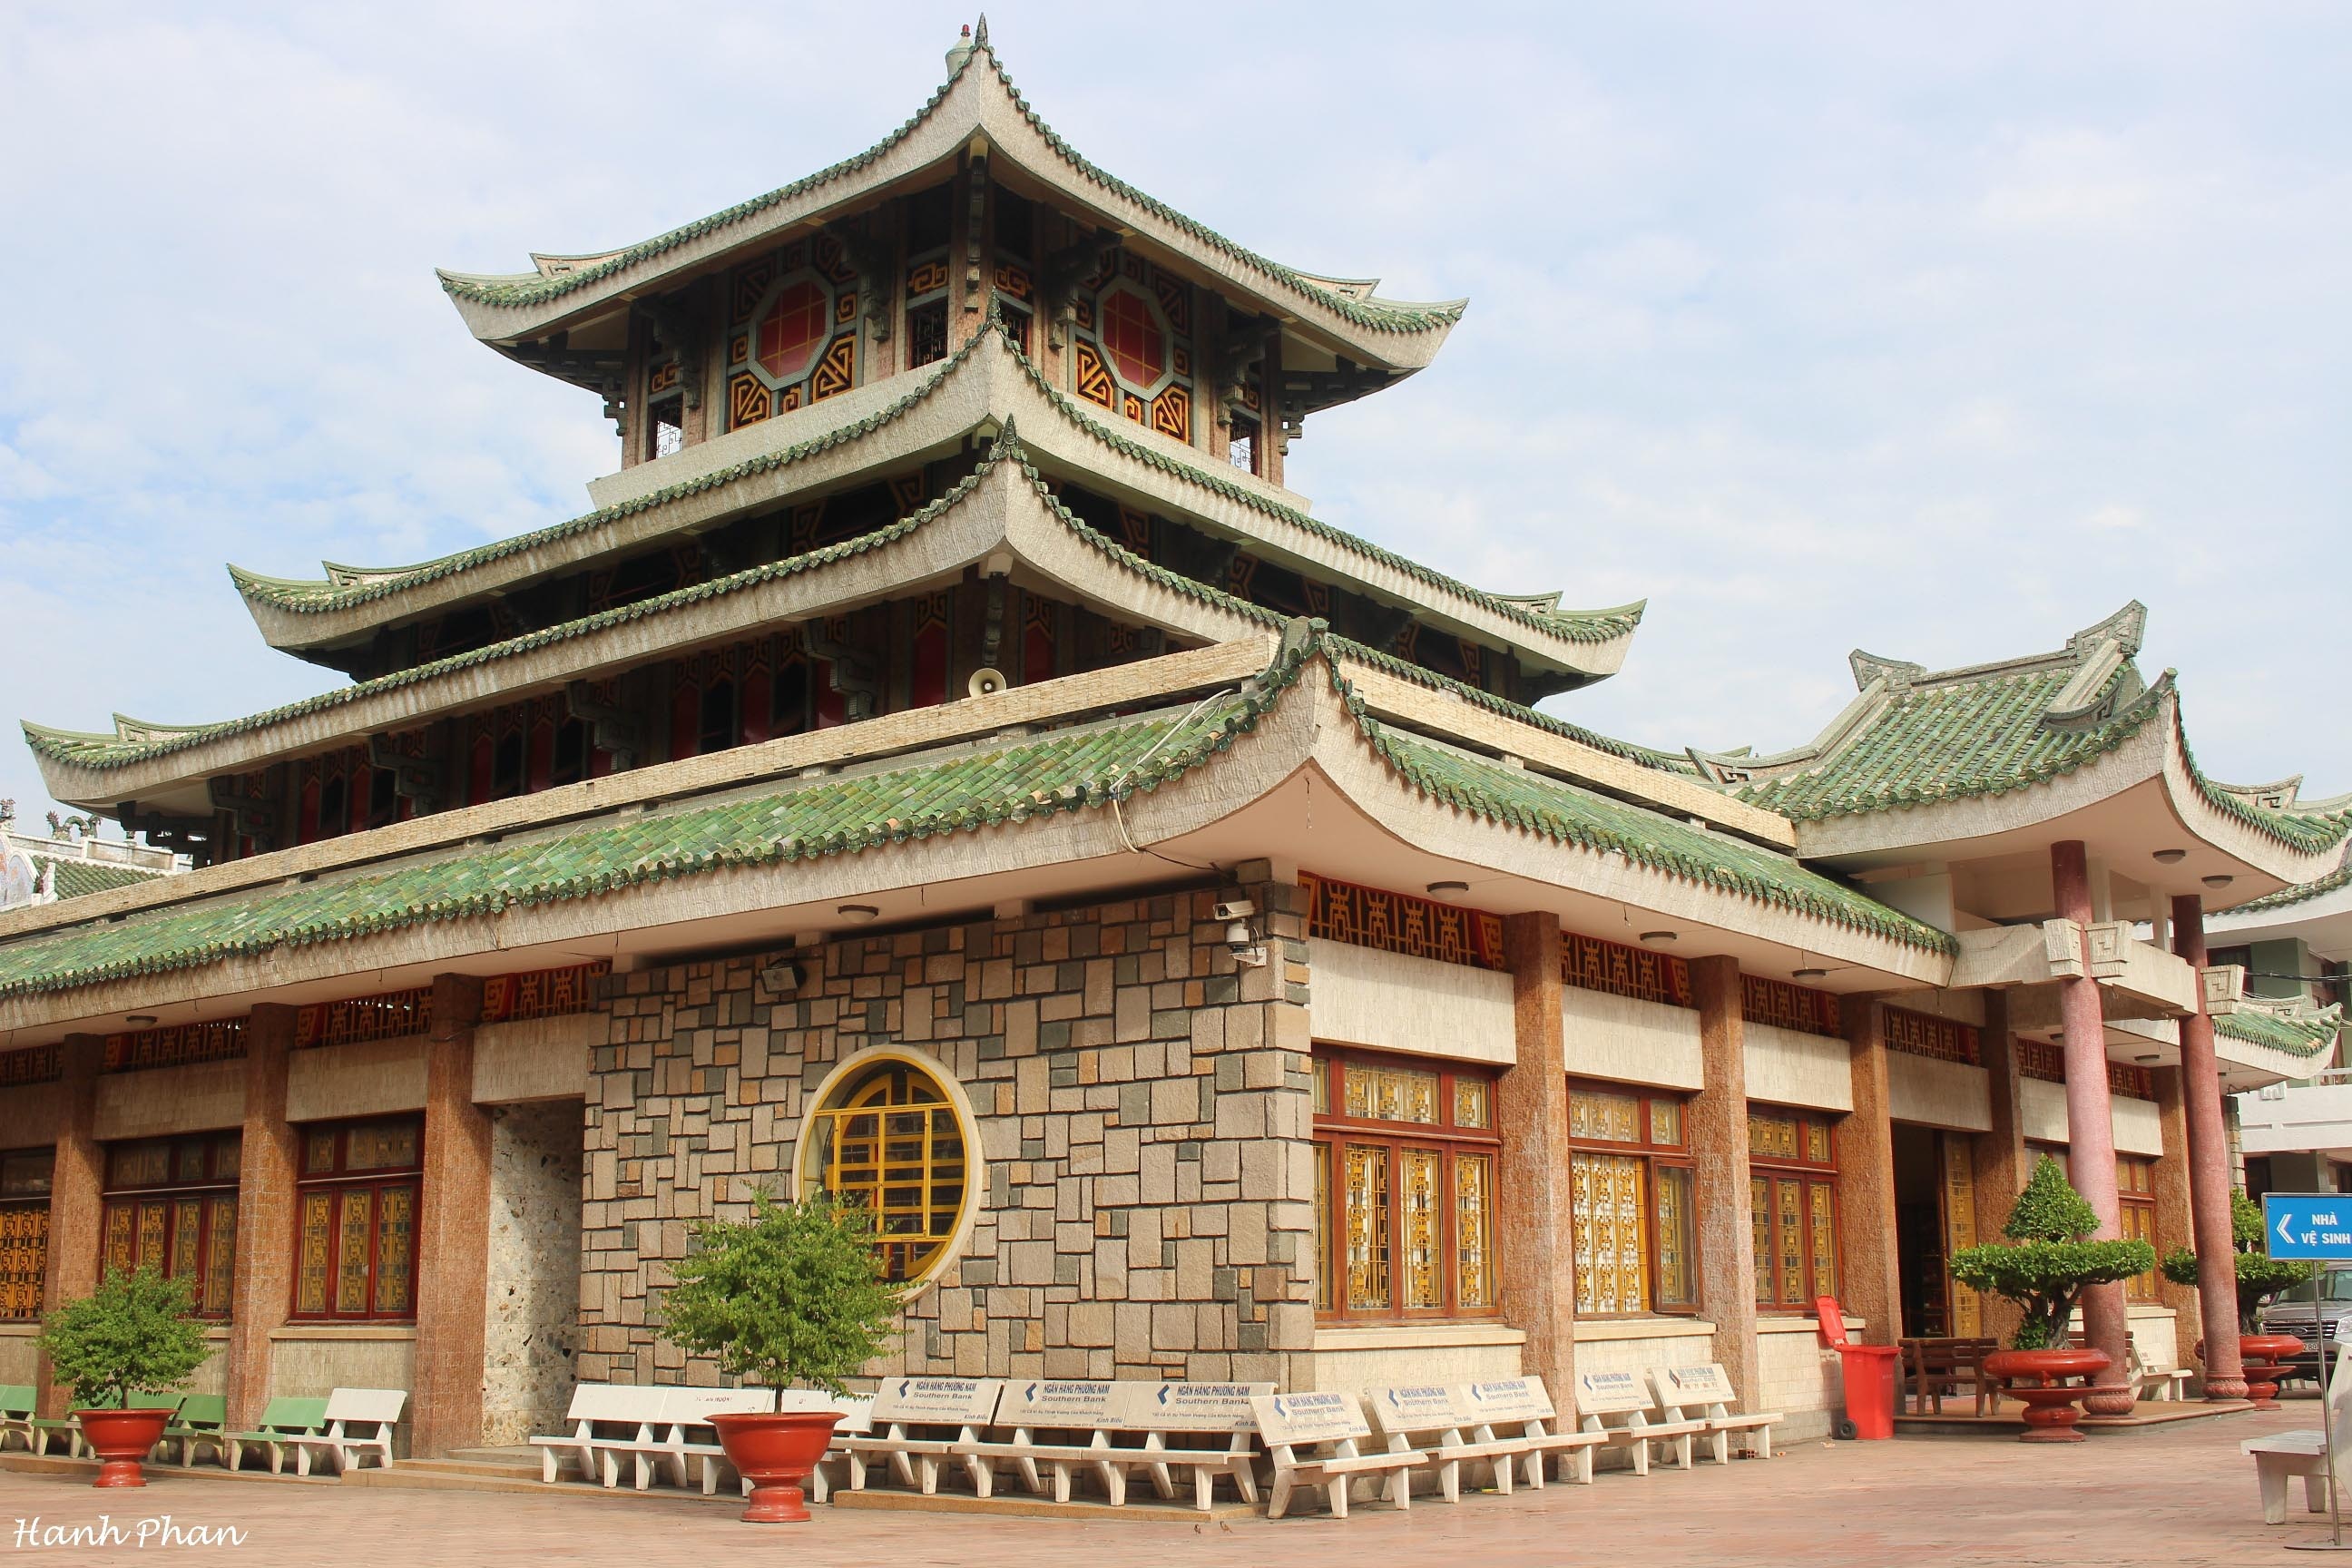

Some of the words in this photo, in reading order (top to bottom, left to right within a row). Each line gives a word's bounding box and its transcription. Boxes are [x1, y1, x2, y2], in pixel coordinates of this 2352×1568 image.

[2312, 1211, 2337, 1225] NHÀ
[2301, 1230, 2318, 1247] VỆ
[2322, 1232, 2351, 1244] SINH
[1292, 1407, 1325, 1416] Southern
[1326, 1406, 1345, 1414] Bank
